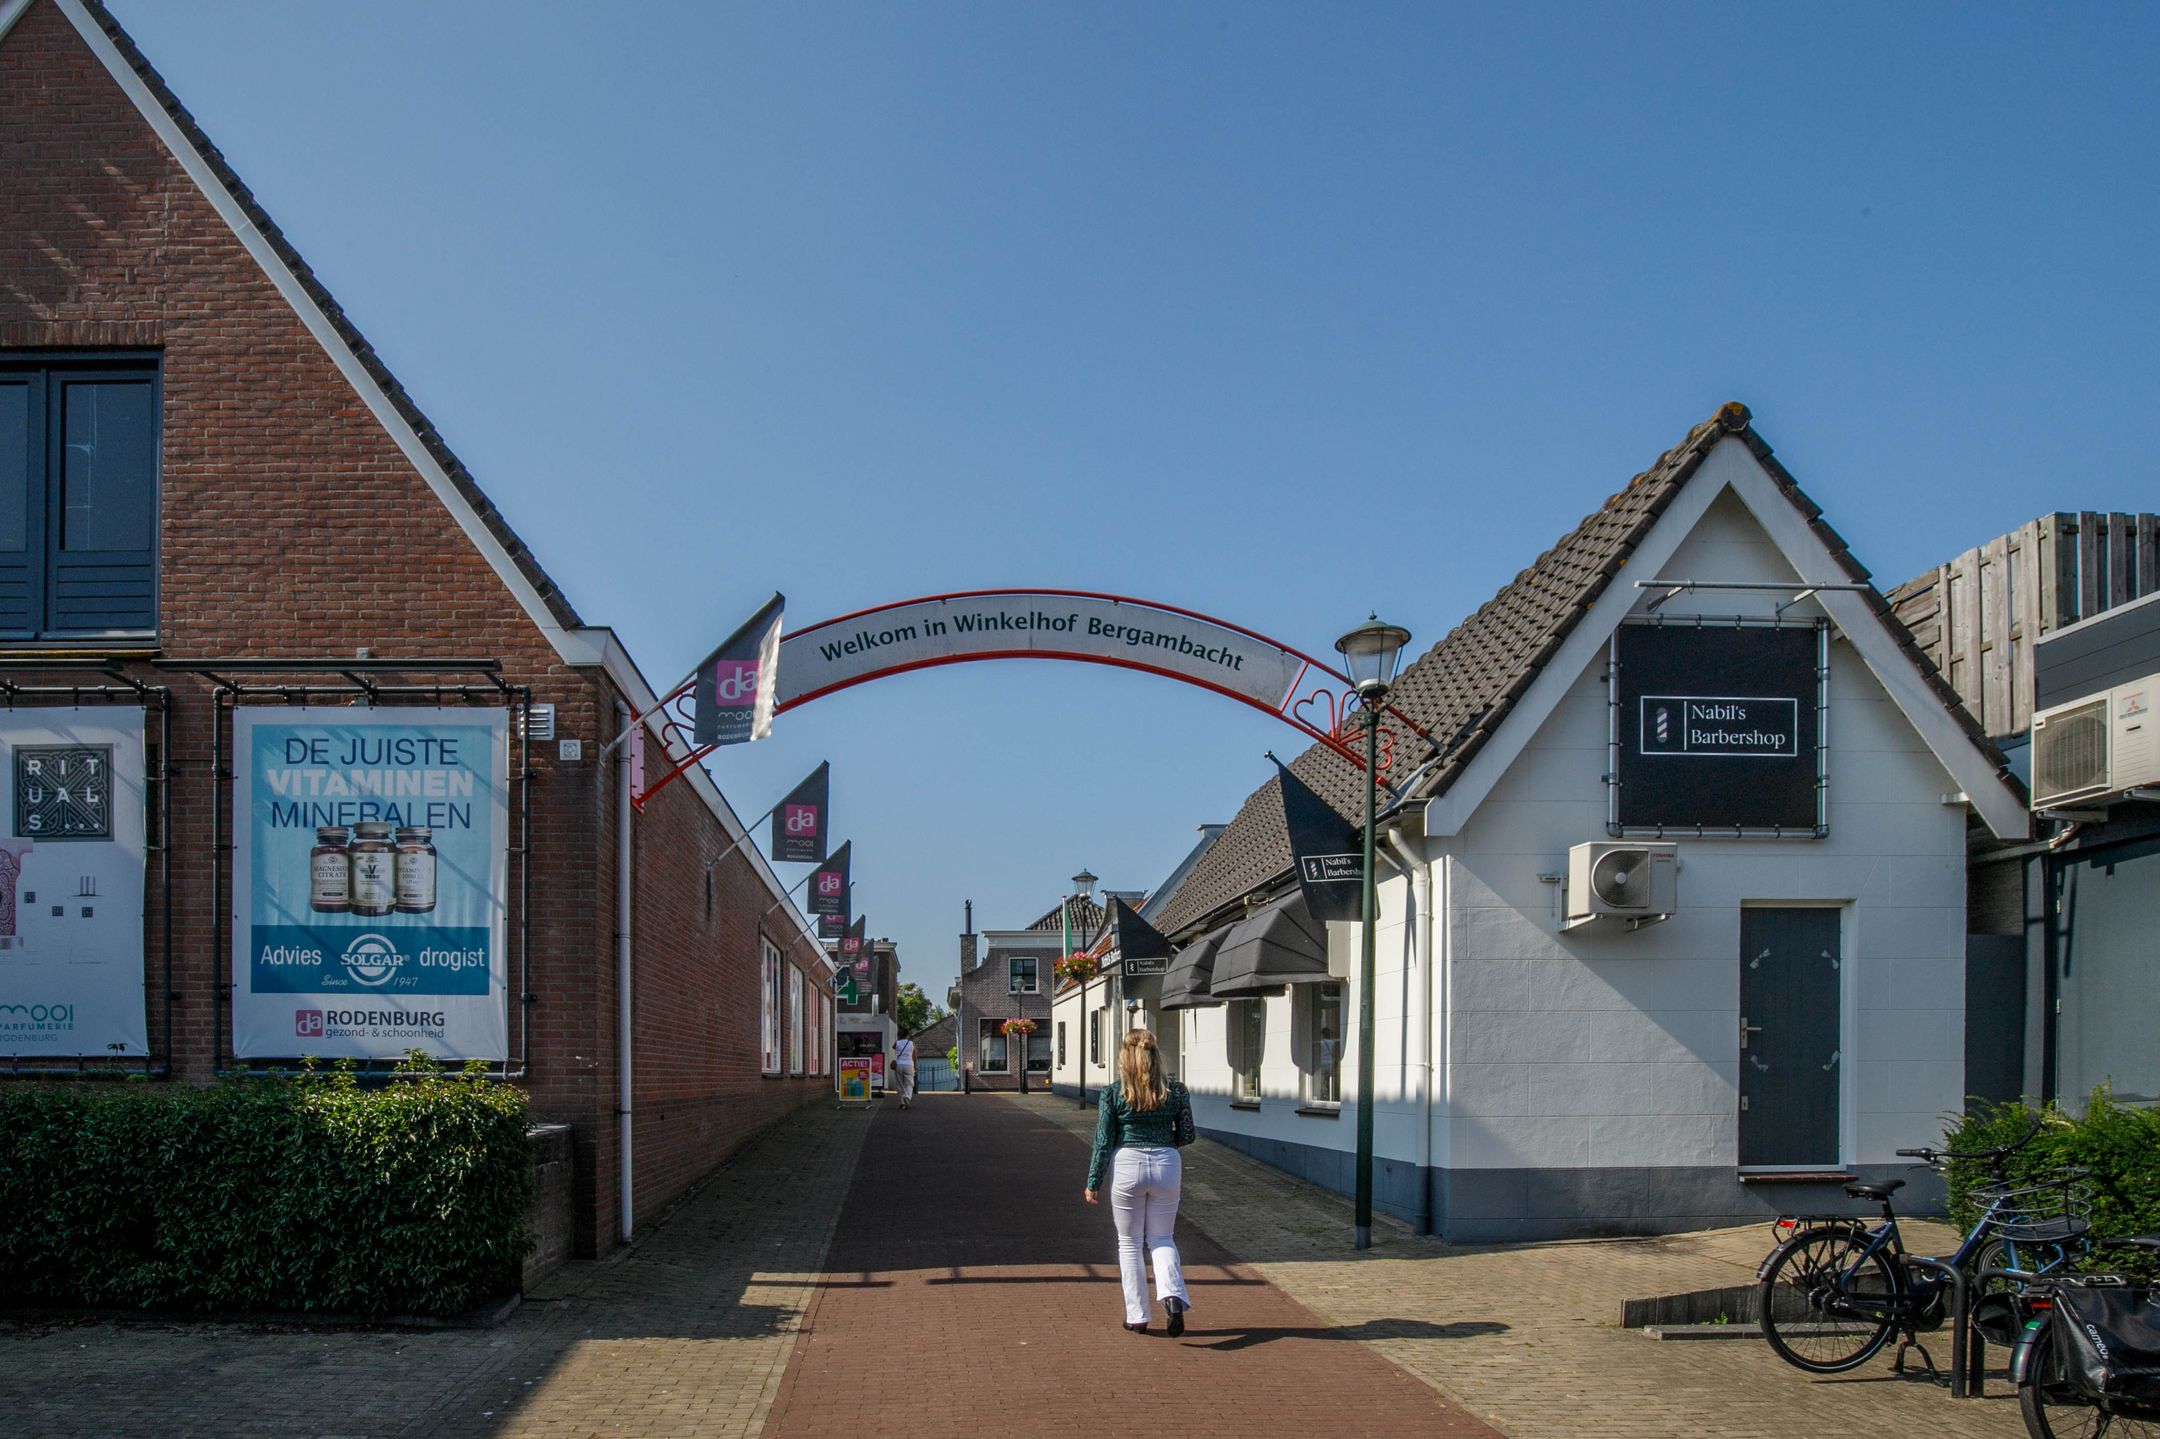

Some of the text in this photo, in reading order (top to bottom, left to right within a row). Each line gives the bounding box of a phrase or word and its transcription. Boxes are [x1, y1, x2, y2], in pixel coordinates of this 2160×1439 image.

[819, 611, 1244, 671] Welkom in Winkelhof Bergambacht
[1691, 704, 1746, 720] Nabil's
[1691, 729, 1786, 749] Barbershop
[285, 738, 458, 765] DE JUISTE
[267, 768, 474, 797] VITAMINEN
[272, 801, 471, 829] MINERALEN
[787, 809, 815, 831] da
[820, 875, 839, 892] da
[260, 945, 322, 965] Advies
[419, 947, 485, 971] drogist
[321, 974, 417, 988] Since 1947
[297, 1013, 322, 1034] da
[327, 1010, 445, 1026] RODENBURG
[325, 1027, 444, 1039] gezond- & schoonheid
[842, 1060, 868, 1068] ACTIE!
